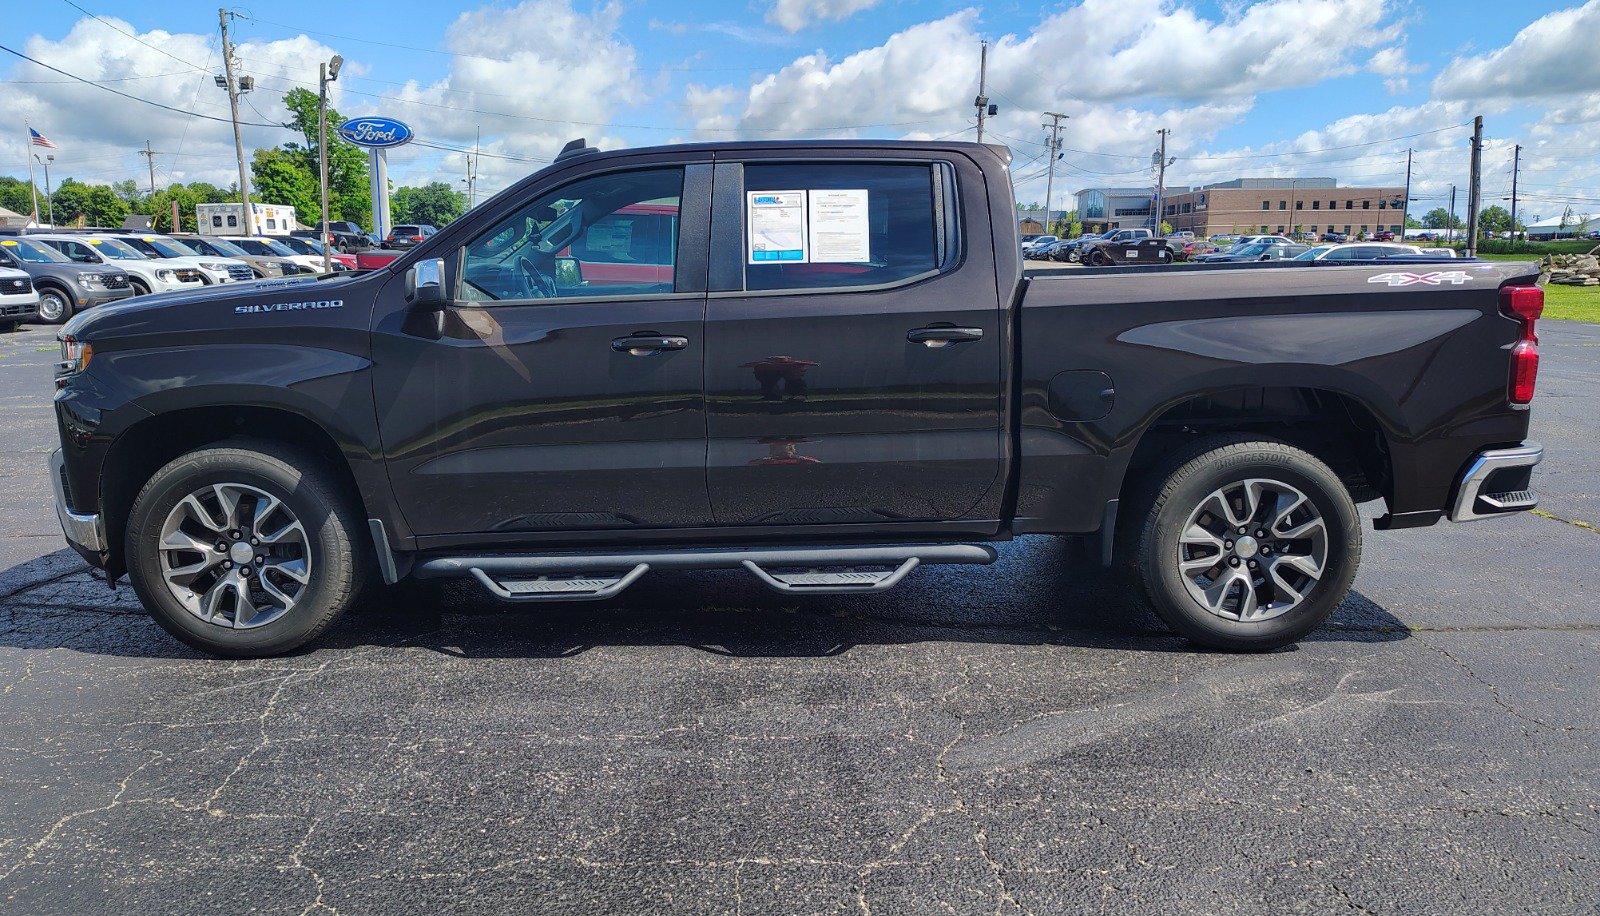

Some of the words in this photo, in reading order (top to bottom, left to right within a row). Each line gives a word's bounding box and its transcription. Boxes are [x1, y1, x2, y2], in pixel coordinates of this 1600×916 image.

[353, 121, 396, 141] Ford
[234, 299, 344, 314] SILVERADO
[1214, 452, 1294, 470] BRIDGESTONE
